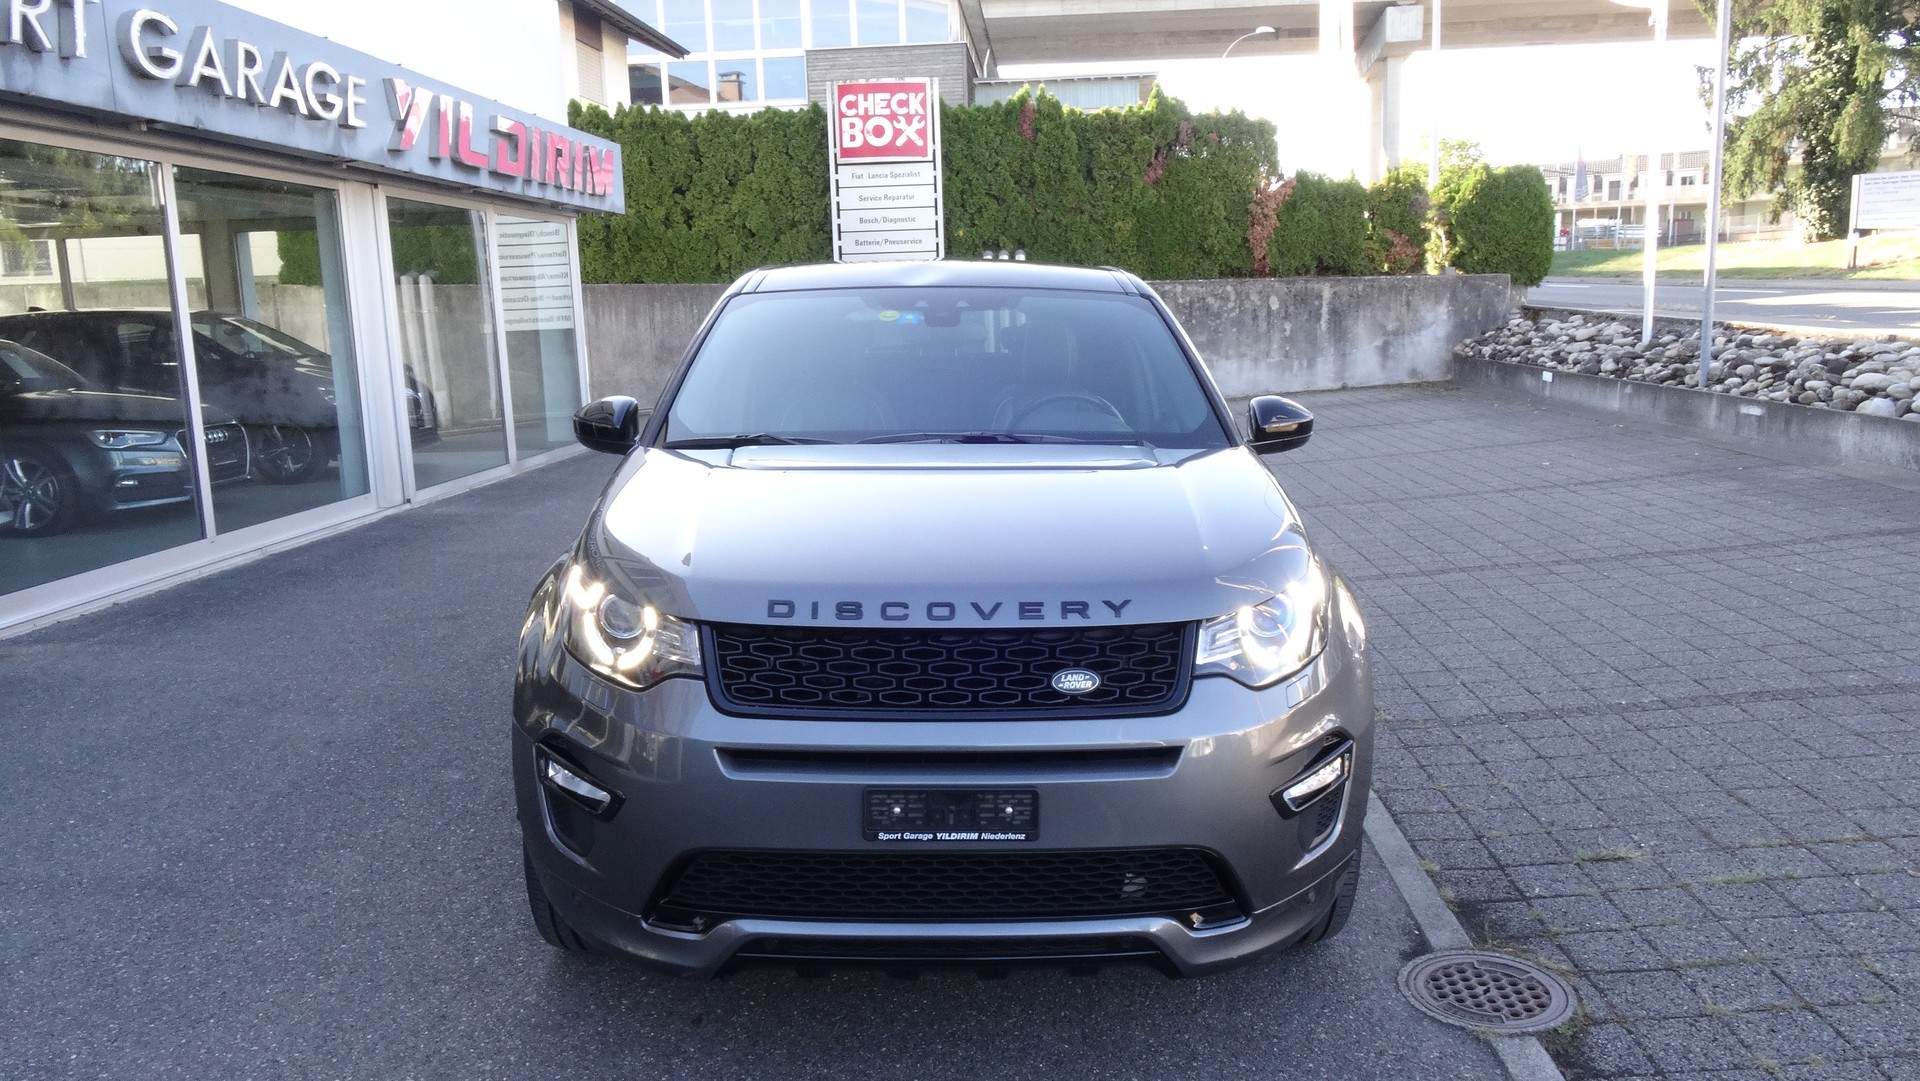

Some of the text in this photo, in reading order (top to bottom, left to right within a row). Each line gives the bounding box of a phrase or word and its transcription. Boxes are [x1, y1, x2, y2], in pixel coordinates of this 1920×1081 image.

[118, 8, 368, 129] GARAGE
[383, 77, 614, 196] YILDIRIM
[839, 92, 926, 116] CHECK
[841, 115, 926, 149] BOX
[851, 171, 920, 181] Fiat Lancia Spezialist
[858, 194, 915, 203] Service Reparatur
[859, 217, 916, 226] Bosch/Diagnostic
[854, 238, 923, 247] Batterie/Pneuservice
[767, 599, 1132, 621] DISCOVERY
[1061, 674, 1084, 682] LAND
[1063, 680, 1092, 689] ROVER
[878, 832, 1026, 841] Sport Garage YILDIRIM Niederlenz
